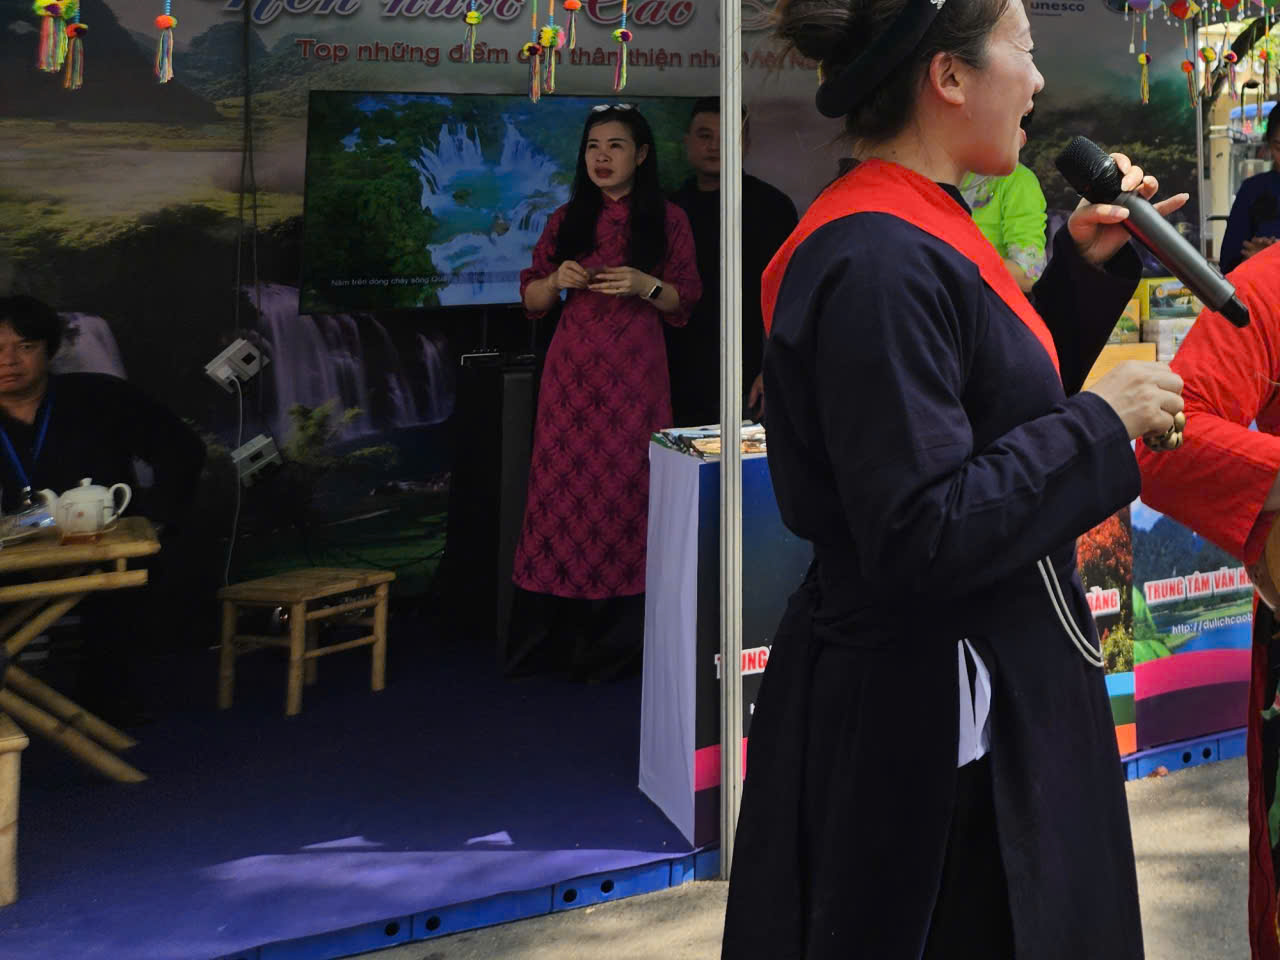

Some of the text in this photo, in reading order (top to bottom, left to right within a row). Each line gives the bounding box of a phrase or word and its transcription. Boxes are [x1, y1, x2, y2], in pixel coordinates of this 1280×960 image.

[297, 40, 349, 63] Top
[356, 41, 440, 65] những
[448, 41, 510, 64] đểm
[1145, 579, 1185, 602] TRUNG
[1187, 572, 1211, 595] TÂM
[1213, 567, 1237, 590] VĂN
